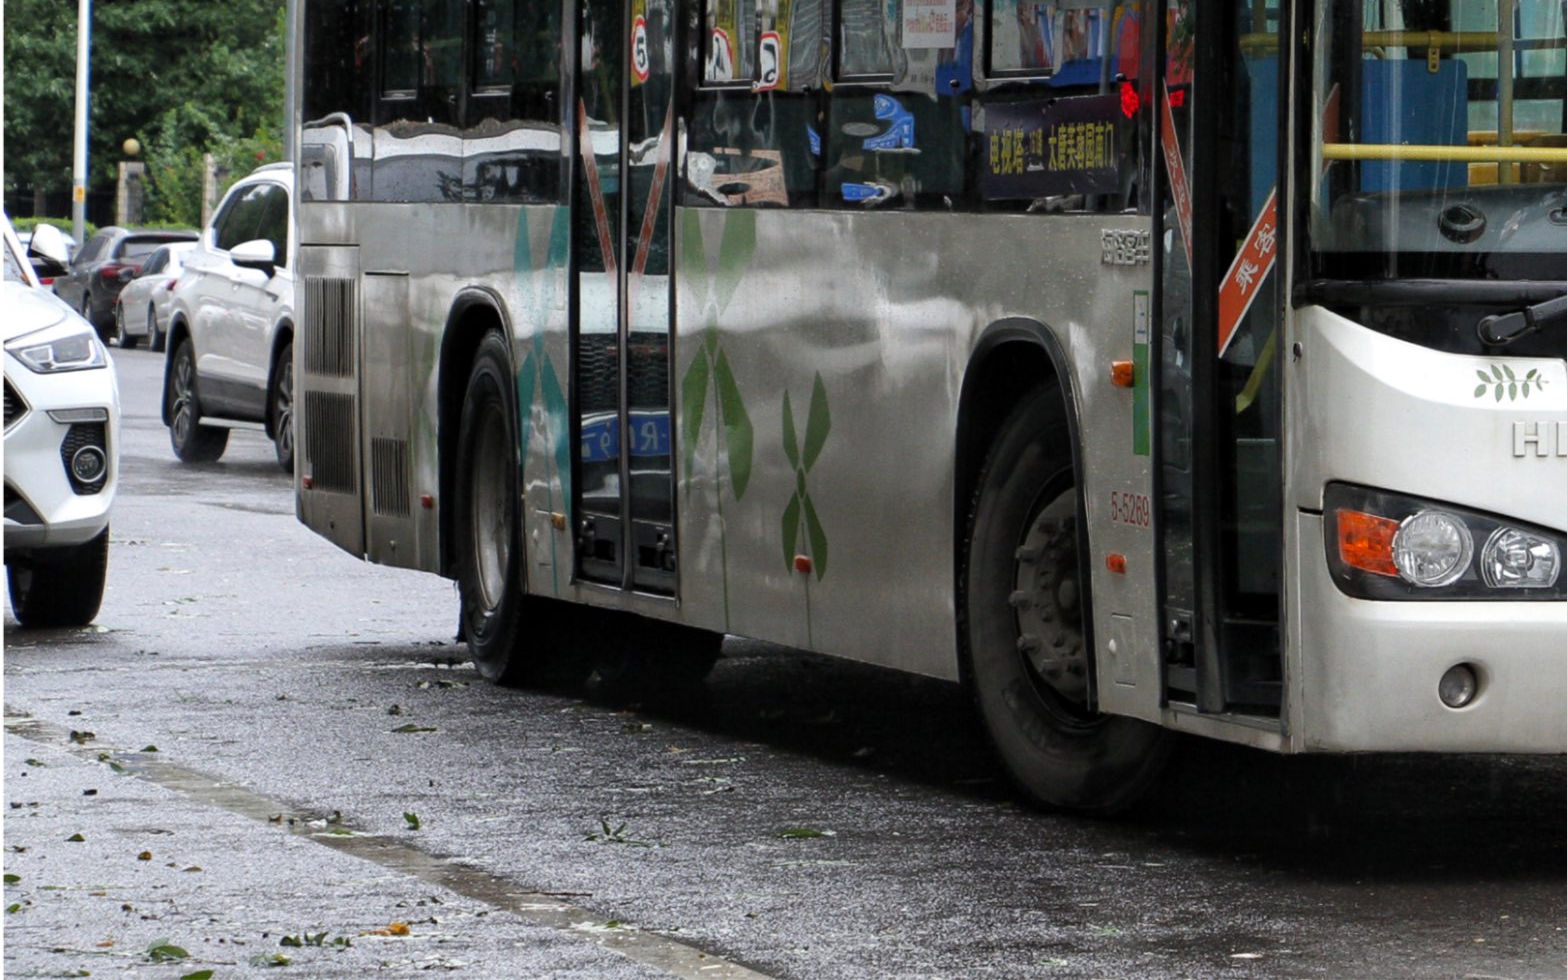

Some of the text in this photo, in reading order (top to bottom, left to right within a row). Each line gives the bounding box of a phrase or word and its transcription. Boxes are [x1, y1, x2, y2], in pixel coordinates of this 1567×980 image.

[990, 128, 1025, 175] 电视塔
[1235, 207, 1277, 295] 乘客
[1111, 490, 1150, 528] 5-5269
